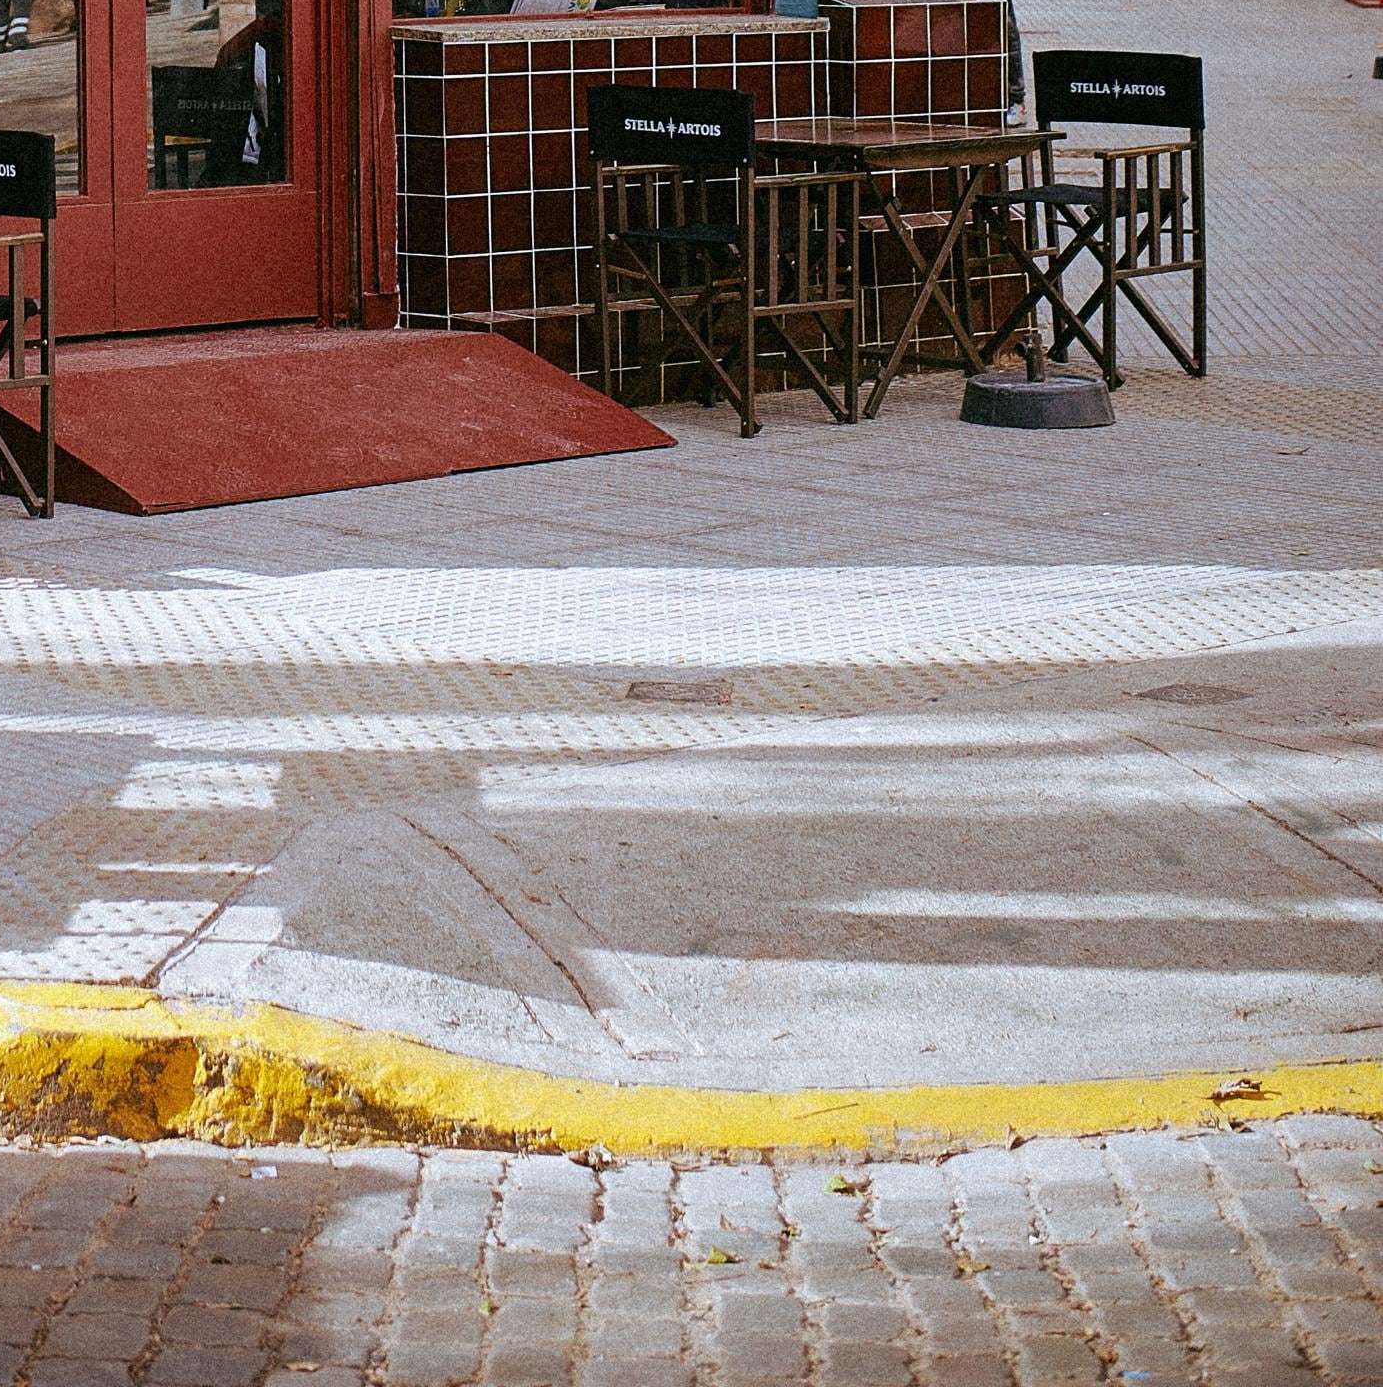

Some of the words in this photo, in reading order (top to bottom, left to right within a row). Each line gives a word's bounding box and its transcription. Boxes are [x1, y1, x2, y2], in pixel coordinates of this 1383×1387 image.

[1069, 82, 1111, 95] STELLA
[1122, 83, 1166, 97] ARTOIS
[624, 118, 666, 133] STELLA
[677, 122, 721, 137] ARTOIS
